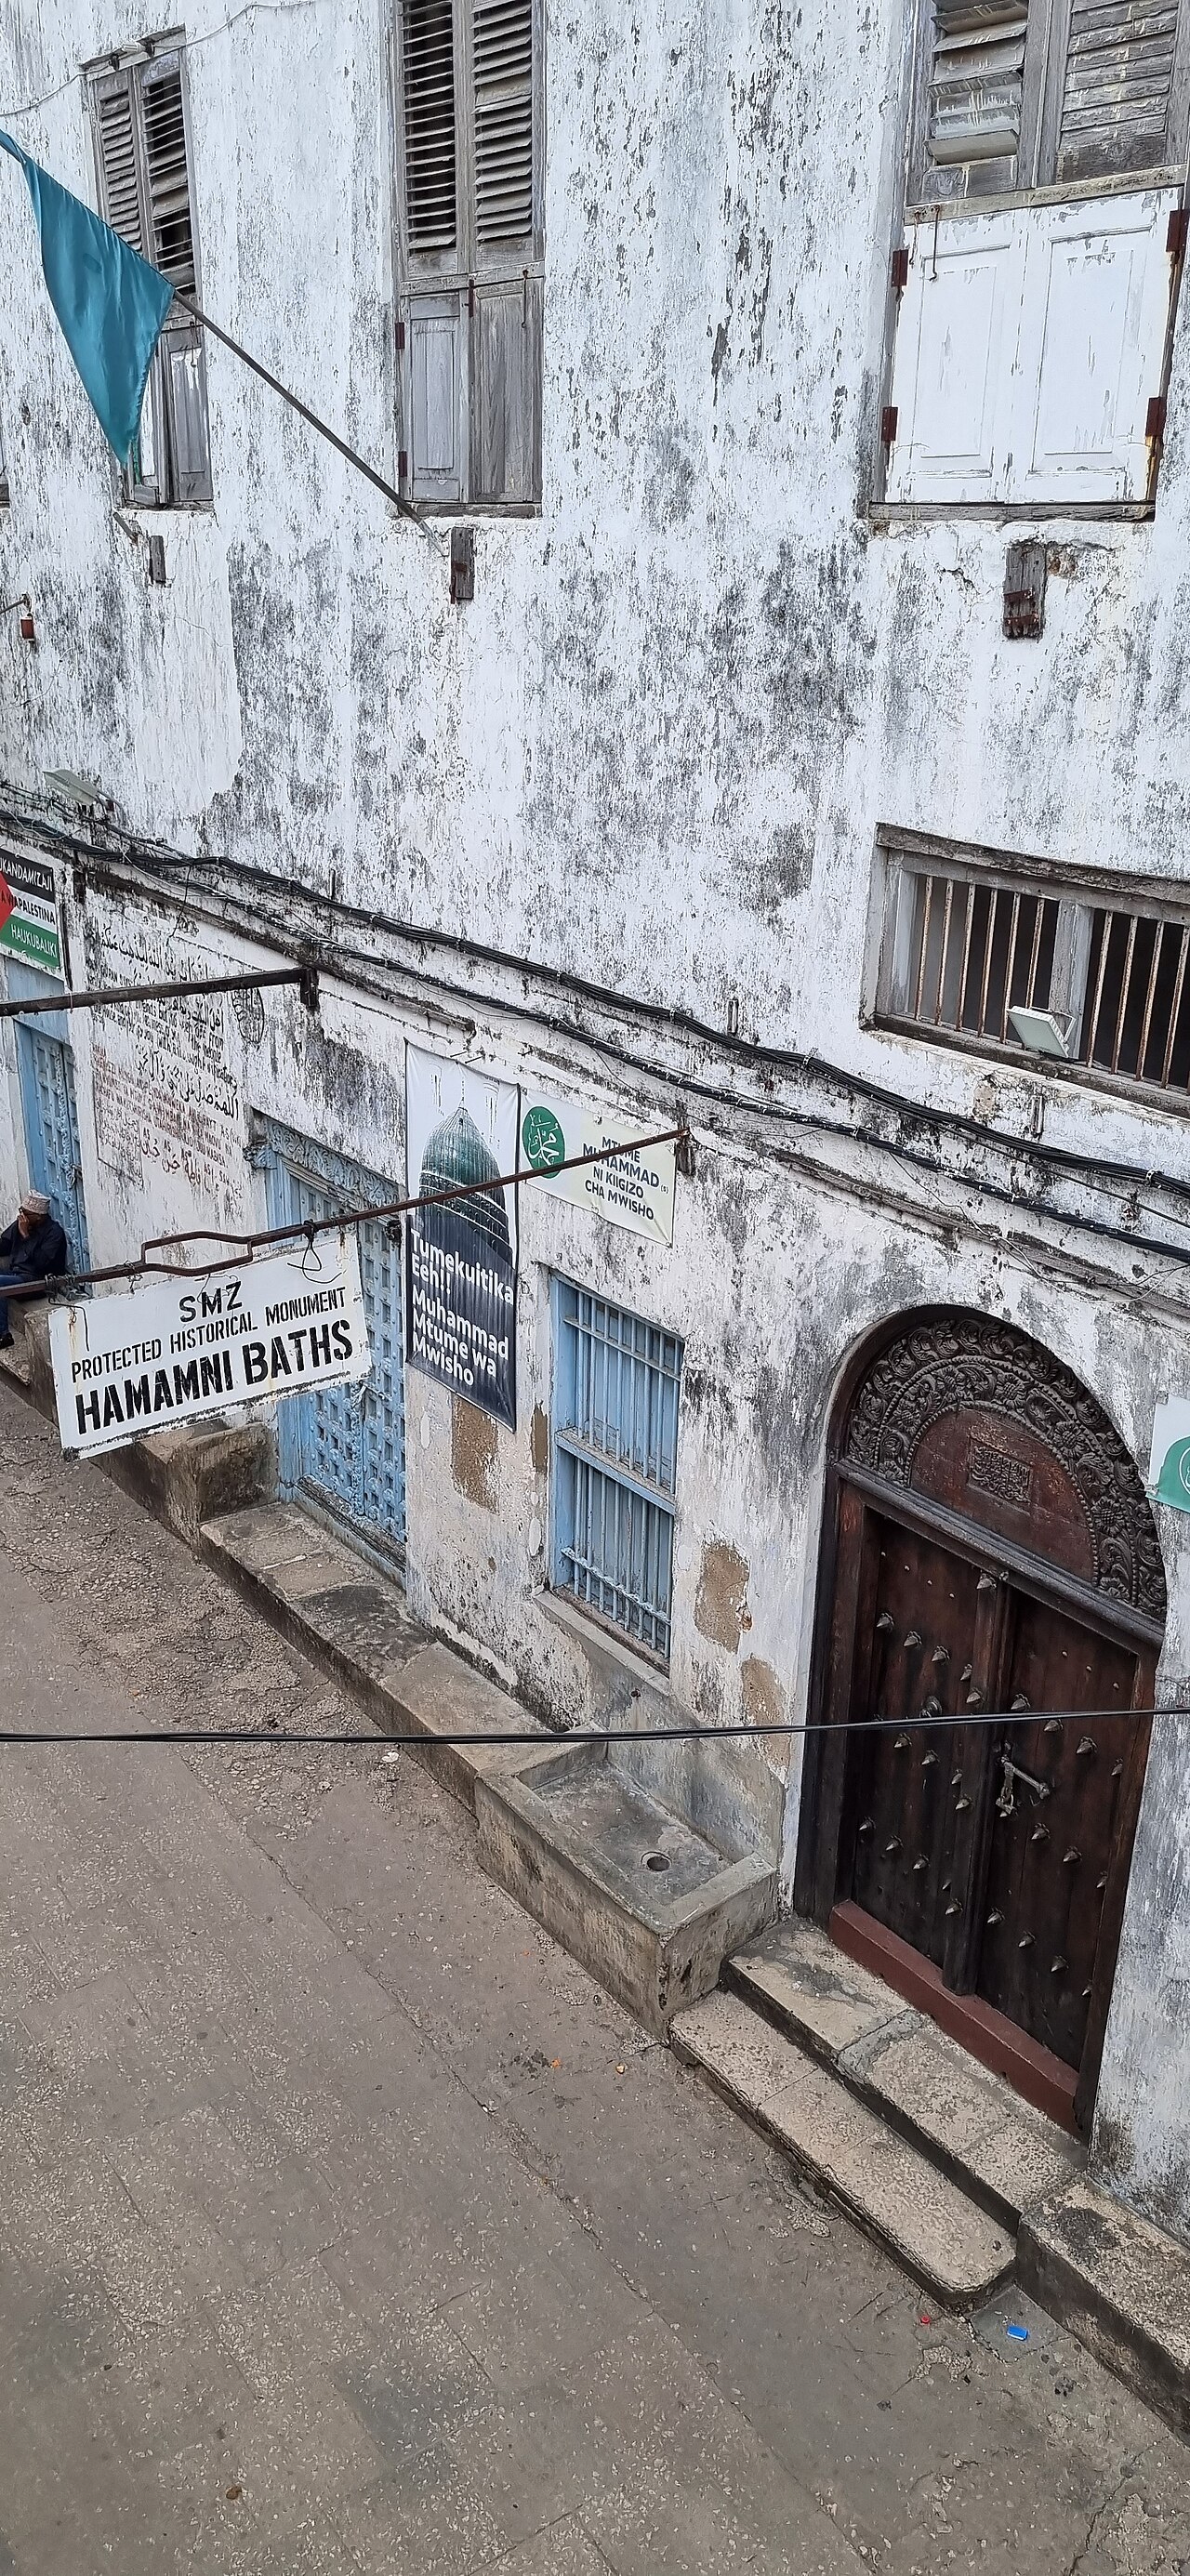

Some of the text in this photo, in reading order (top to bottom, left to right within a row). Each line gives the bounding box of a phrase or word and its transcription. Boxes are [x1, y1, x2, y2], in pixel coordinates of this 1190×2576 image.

[11, 924, 58, 958] HAUKUBALIKI
[585, 1179, 654, 1221] CHA MWISHO
[593, 1166, 644, 1199] NI KIIGIZO
[411, 1228, 514, 1306] Tumekuitika
[412, 1253, 451, 1295] Eeh!!
[178, 1280, 243, 1323] SMZ
[412, 1284, 509, 1360] Muhammad
[71, 1287, 346, 1383] PROTECTED HISTORICAL MONUMENT
[413, 1307, 496, 1378] Mtume wa
[413, 1330, 474, 1386] Mwisho
[75, 1318, 353, 1435] HAMAMNI BATHS
